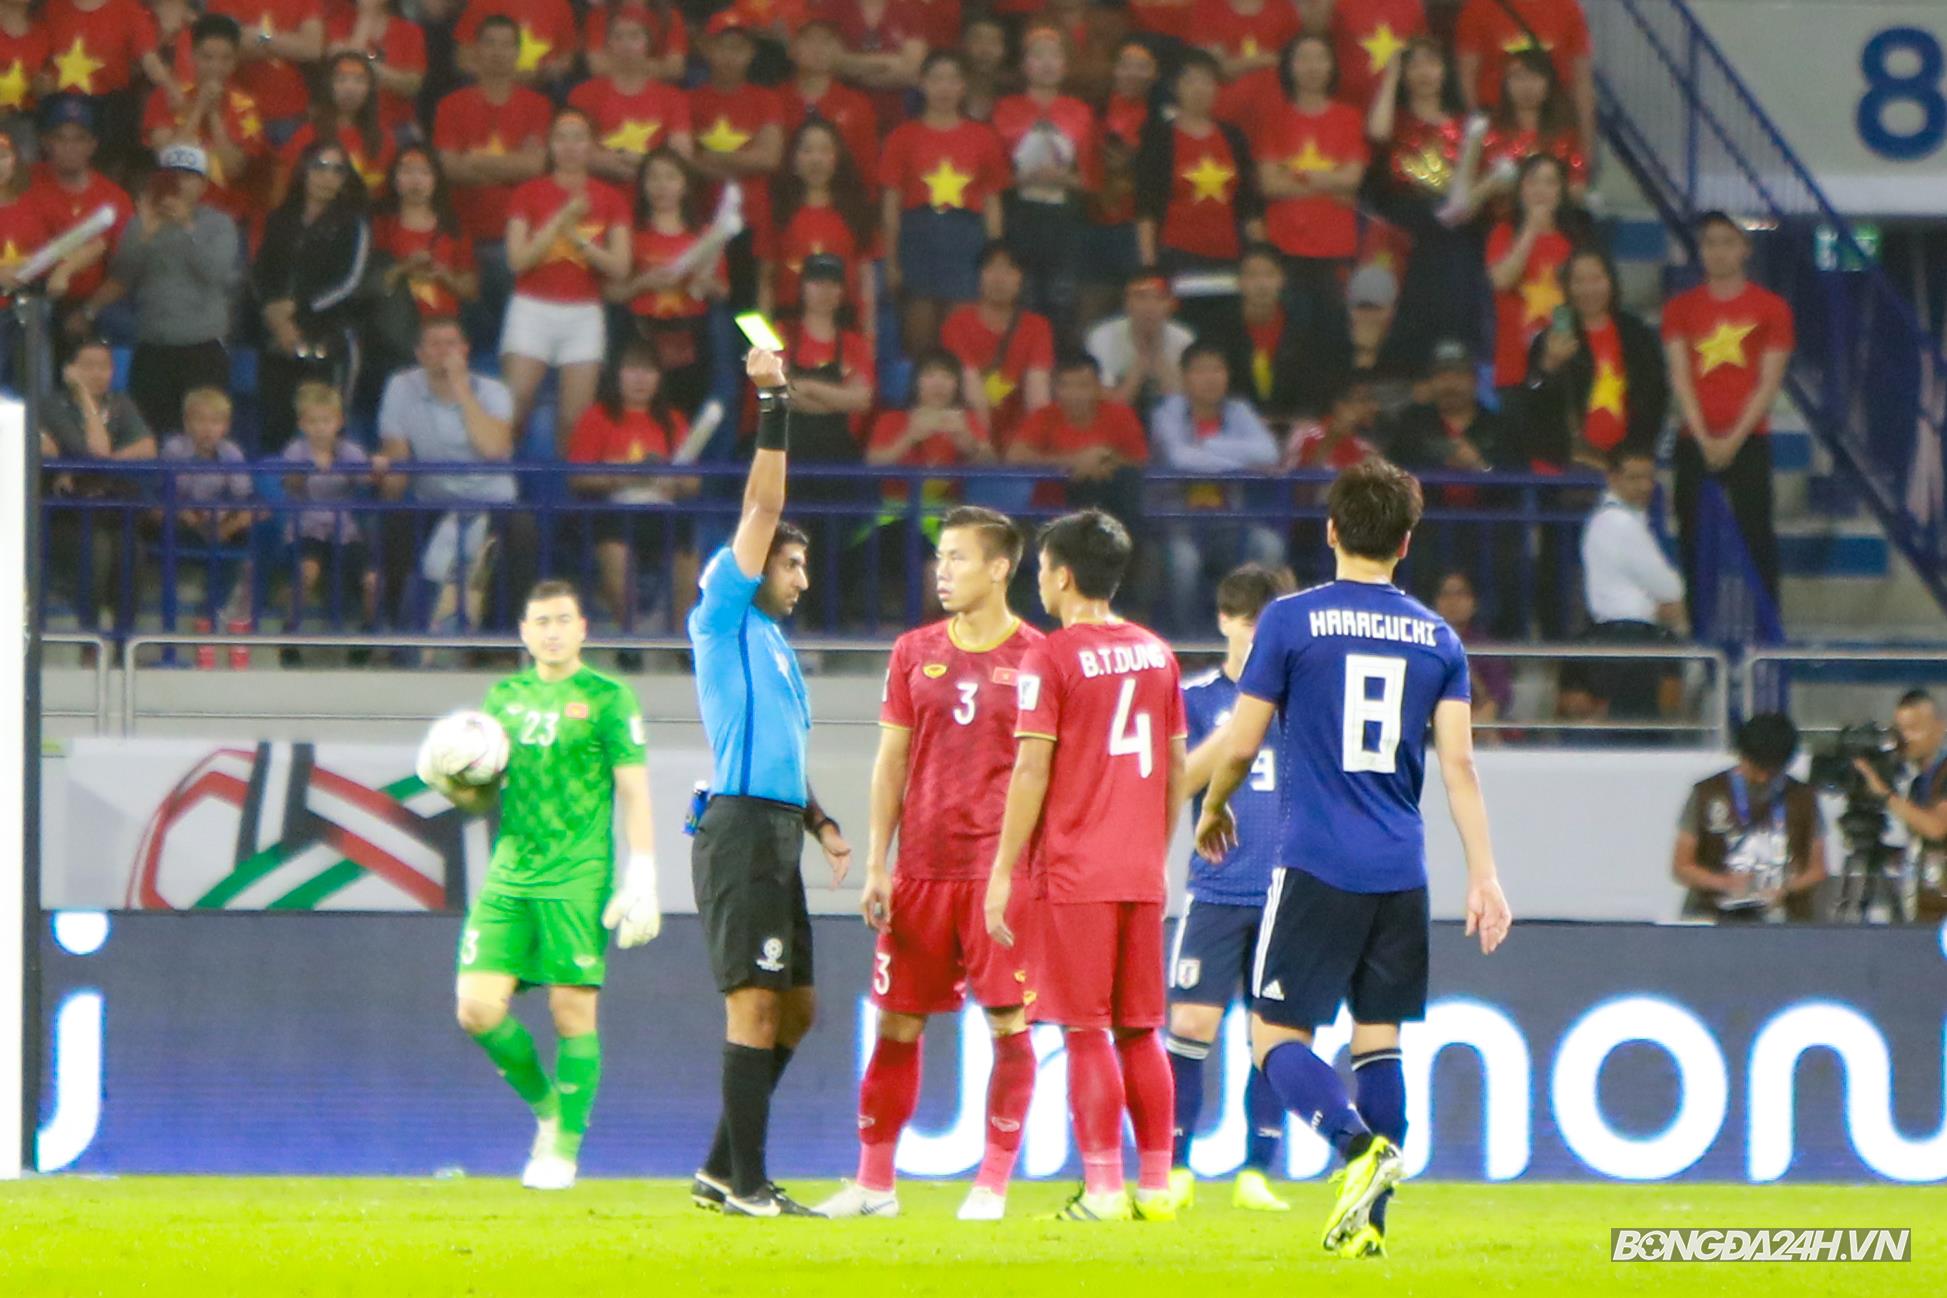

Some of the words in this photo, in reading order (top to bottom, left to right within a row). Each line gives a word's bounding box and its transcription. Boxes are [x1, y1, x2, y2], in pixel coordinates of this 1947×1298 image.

[1857, 27, 1947, 160] 8
[1309, 609, 1437, 647] HARAGUCHI
[953, 682, 978, 725] 3
[1342, 654, 1407, 774] 8
[520, 710, 560, 747] 23
[1109, 678, 1153, 778] 4
[874, 952, 892, 996] 3
